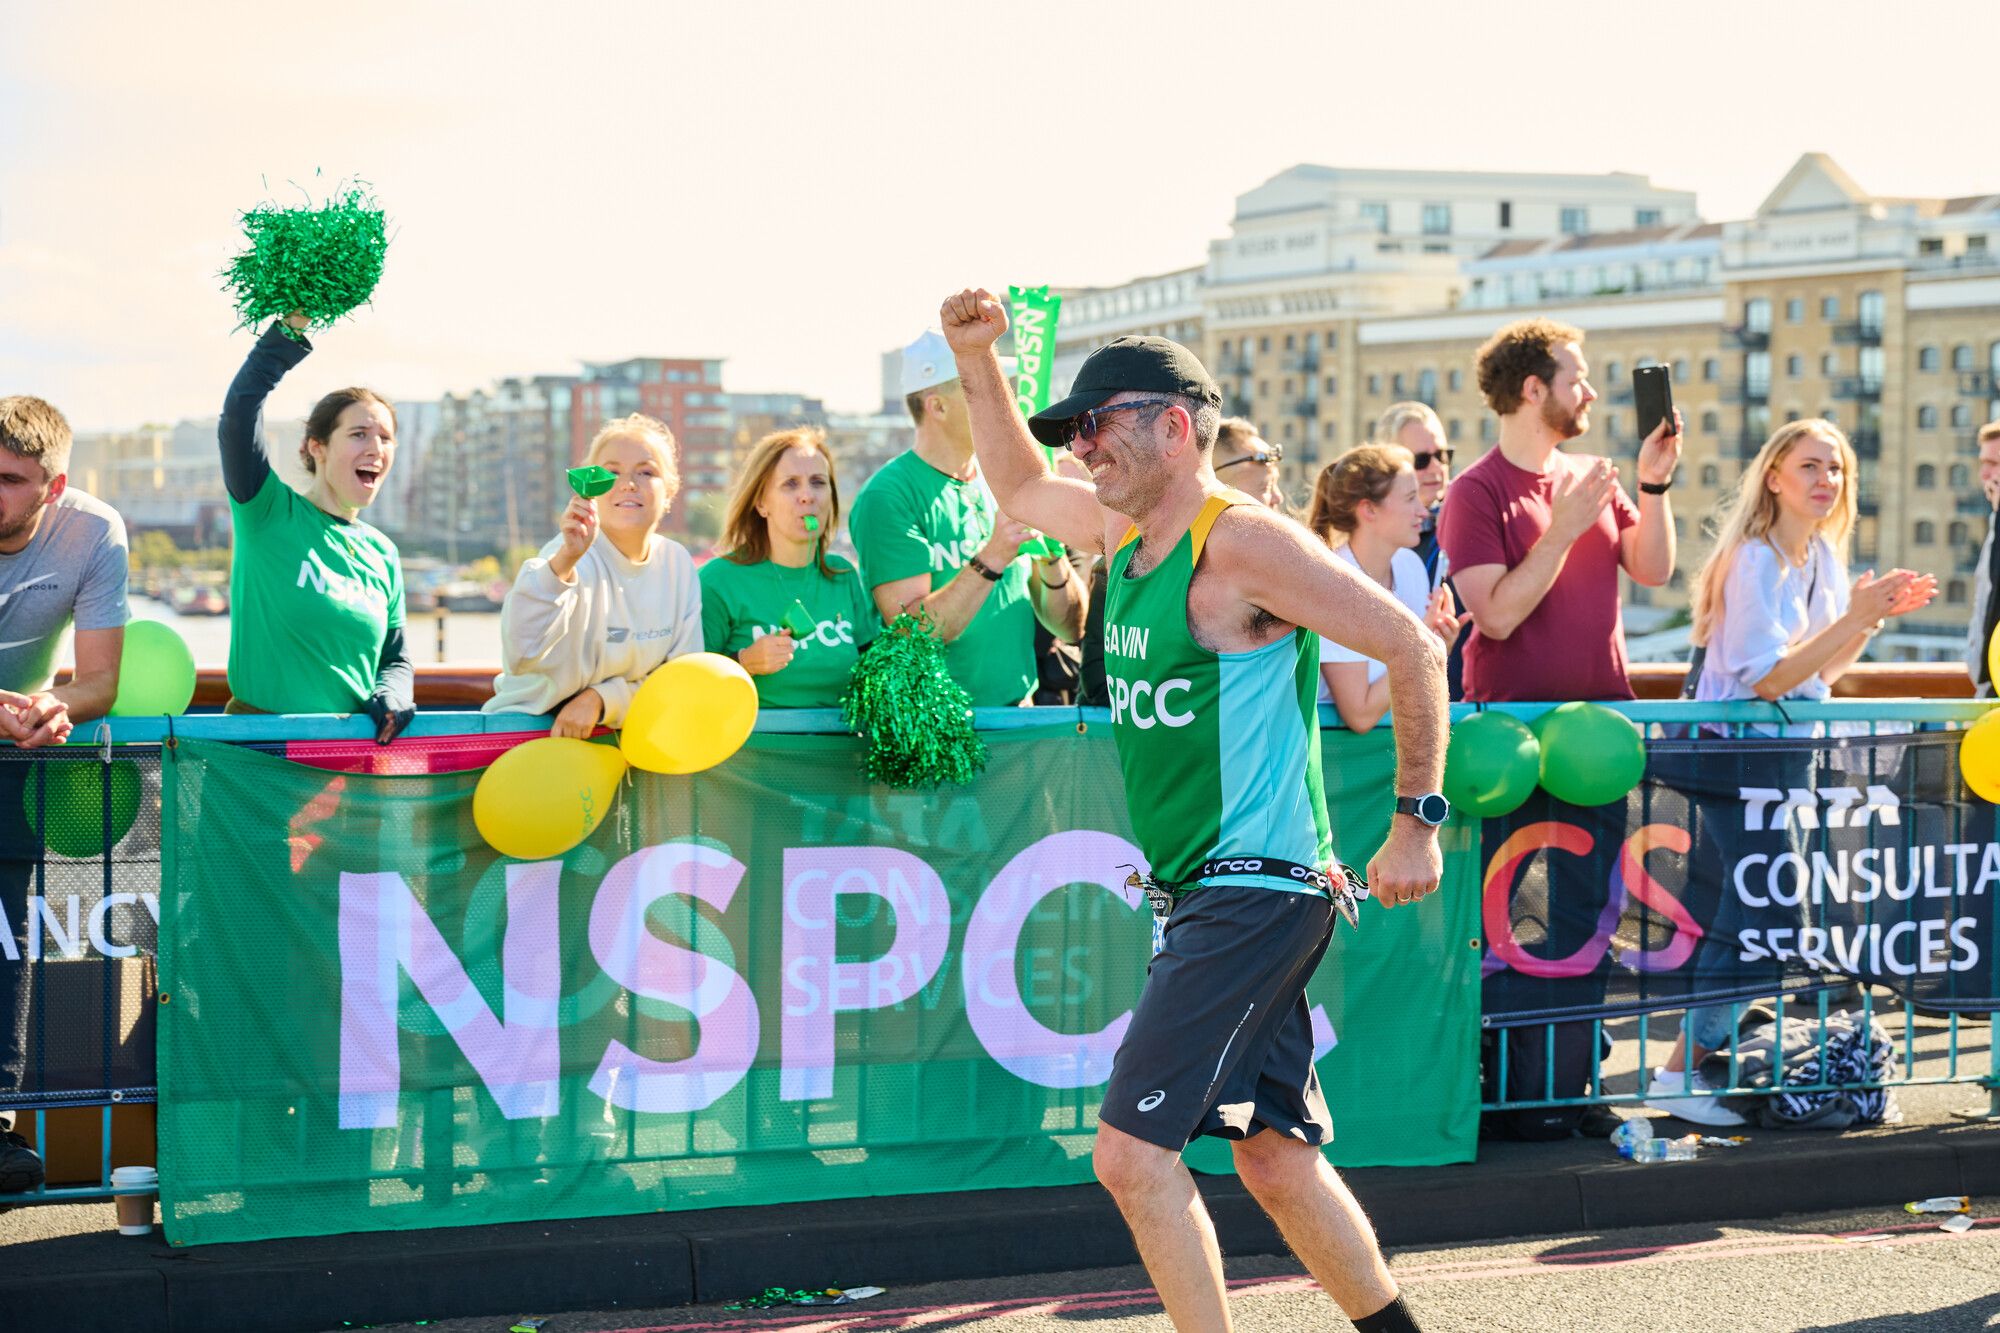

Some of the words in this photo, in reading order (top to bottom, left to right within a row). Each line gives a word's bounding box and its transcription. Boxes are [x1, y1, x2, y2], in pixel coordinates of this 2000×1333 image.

[1104, 621, 1149, 660] GAVIN
[1738, 785, 1901, 832] TATA
[1733, 842, 2000, 908] CONSULTA
[1737, 917, 1979, 976] SERVICES
[337, 830, 1339, 1131] NSPC
